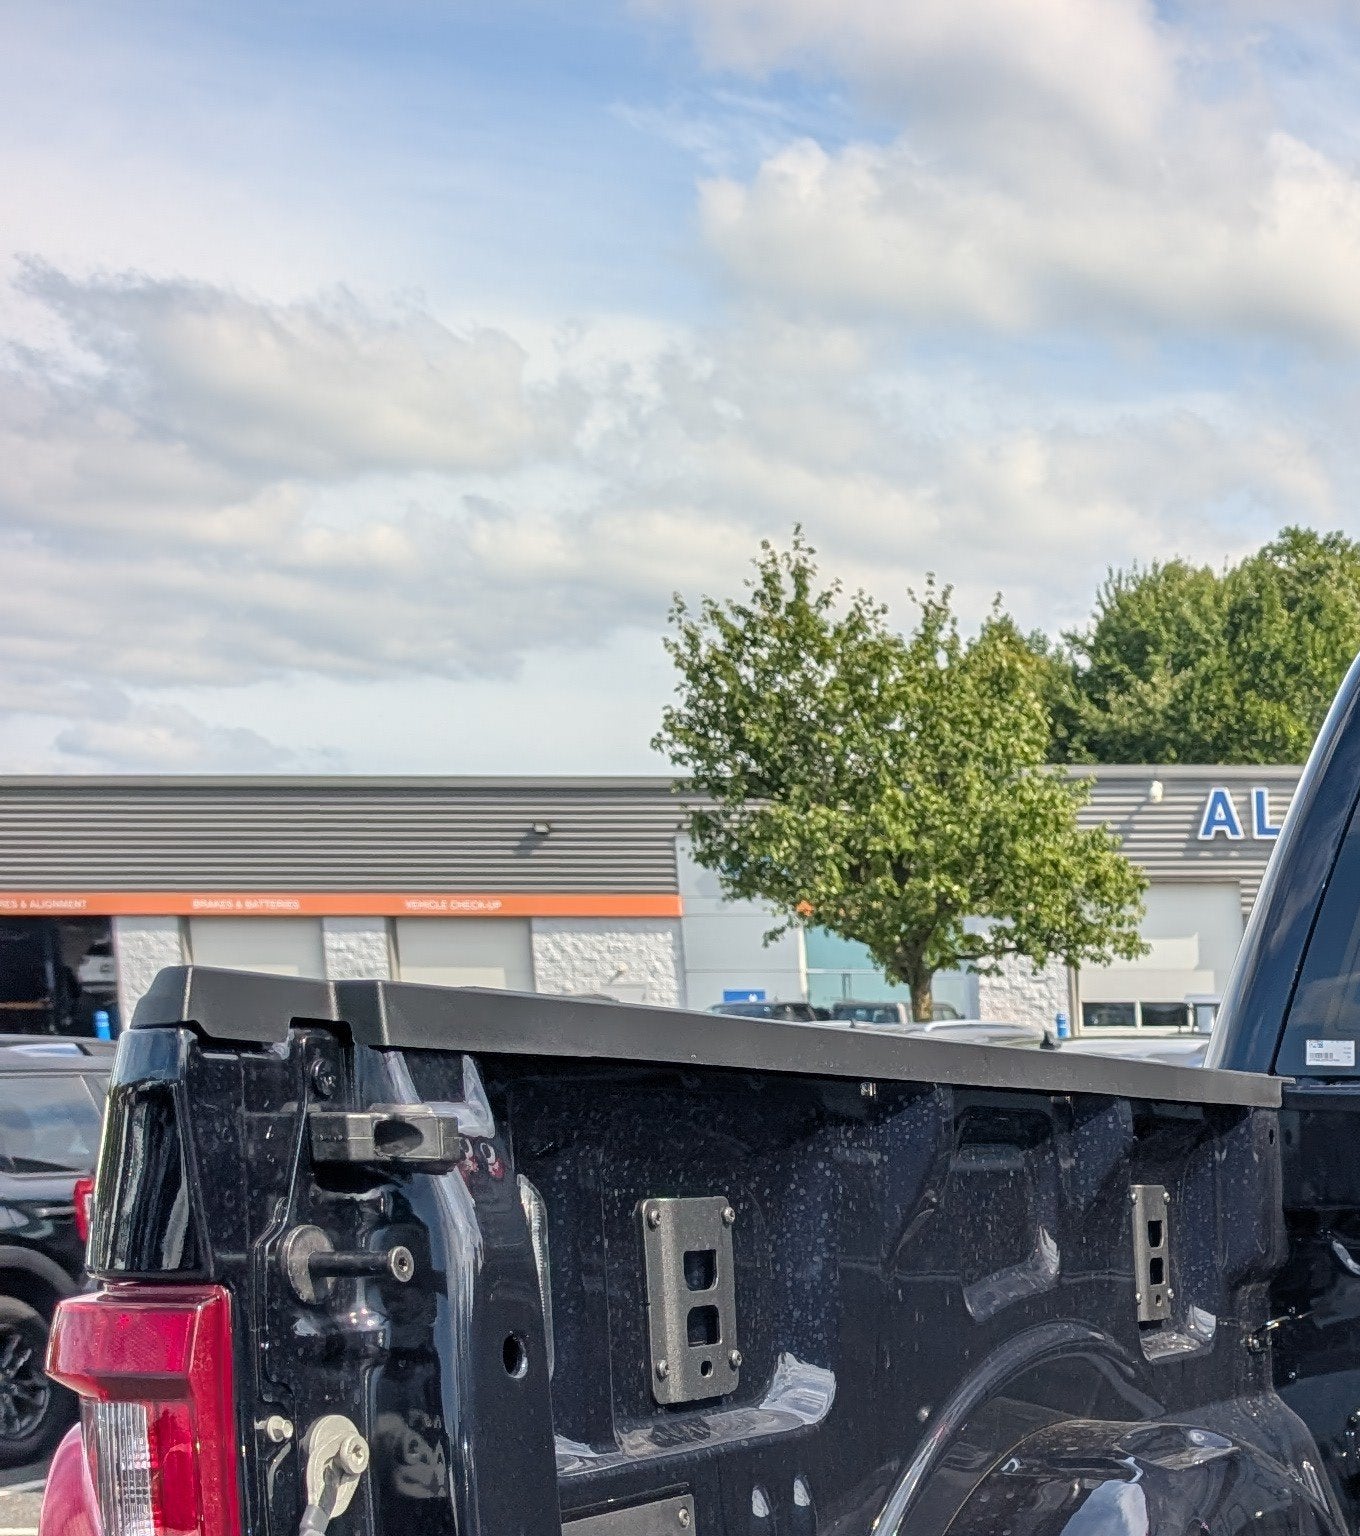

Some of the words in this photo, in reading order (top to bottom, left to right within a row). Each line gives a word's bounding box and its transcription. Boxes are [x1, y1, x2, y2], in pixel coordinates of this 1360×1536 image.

[30, 899, 87, 909] ALIGNMENT
[192, 899, 233, 909] BRAKES
[245, 899, 300, 910] BATTERIES
[405, 900, 446, 911] VEHICLE
